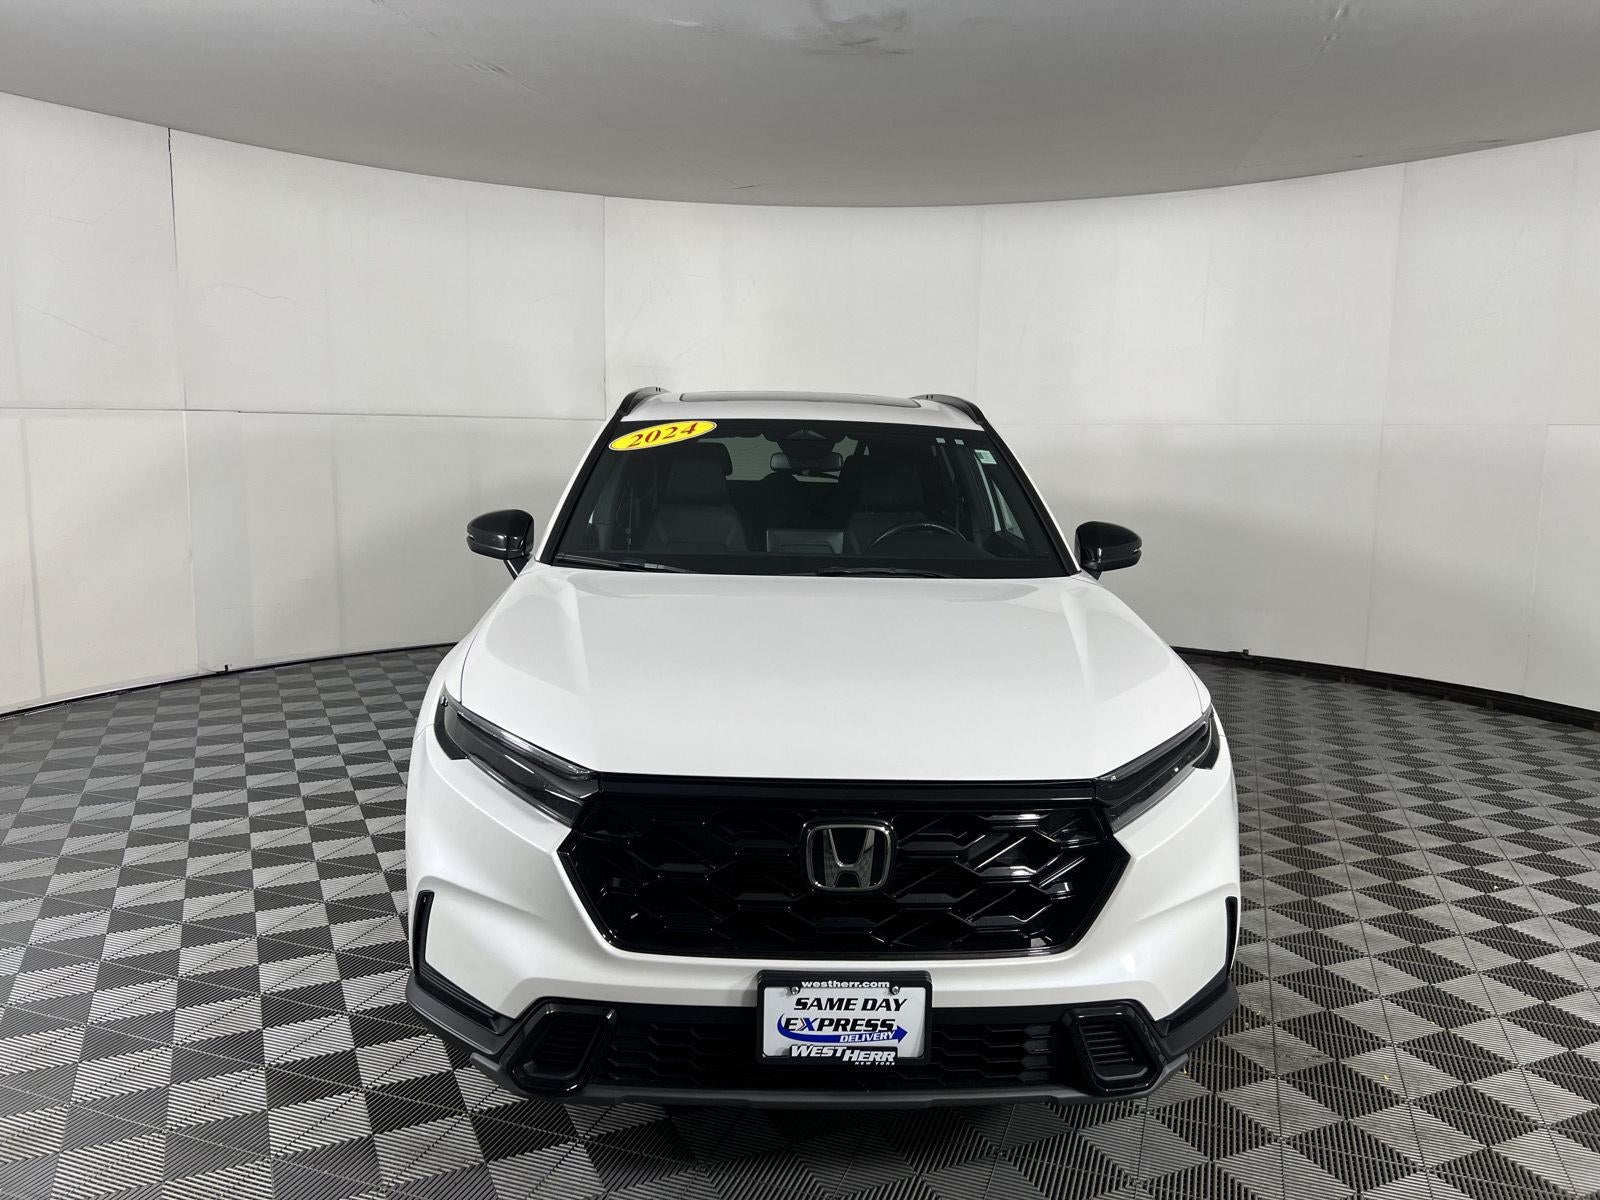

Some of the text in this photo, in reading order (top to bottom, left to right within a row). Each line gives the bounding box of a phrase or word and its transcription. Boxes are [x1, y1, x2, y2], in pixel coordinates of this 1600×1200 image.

[628, 422, 698, 448] 2024
[801, 980, 890, 989] westherr.com
[794, 997, 908, 1012] SAME DAY
[783, 1017, 896, 1032] EXPRESS
[839, 1031, 896, 1044] DELIVERY
[791, 1044, 896, 1062] WEST HERR
